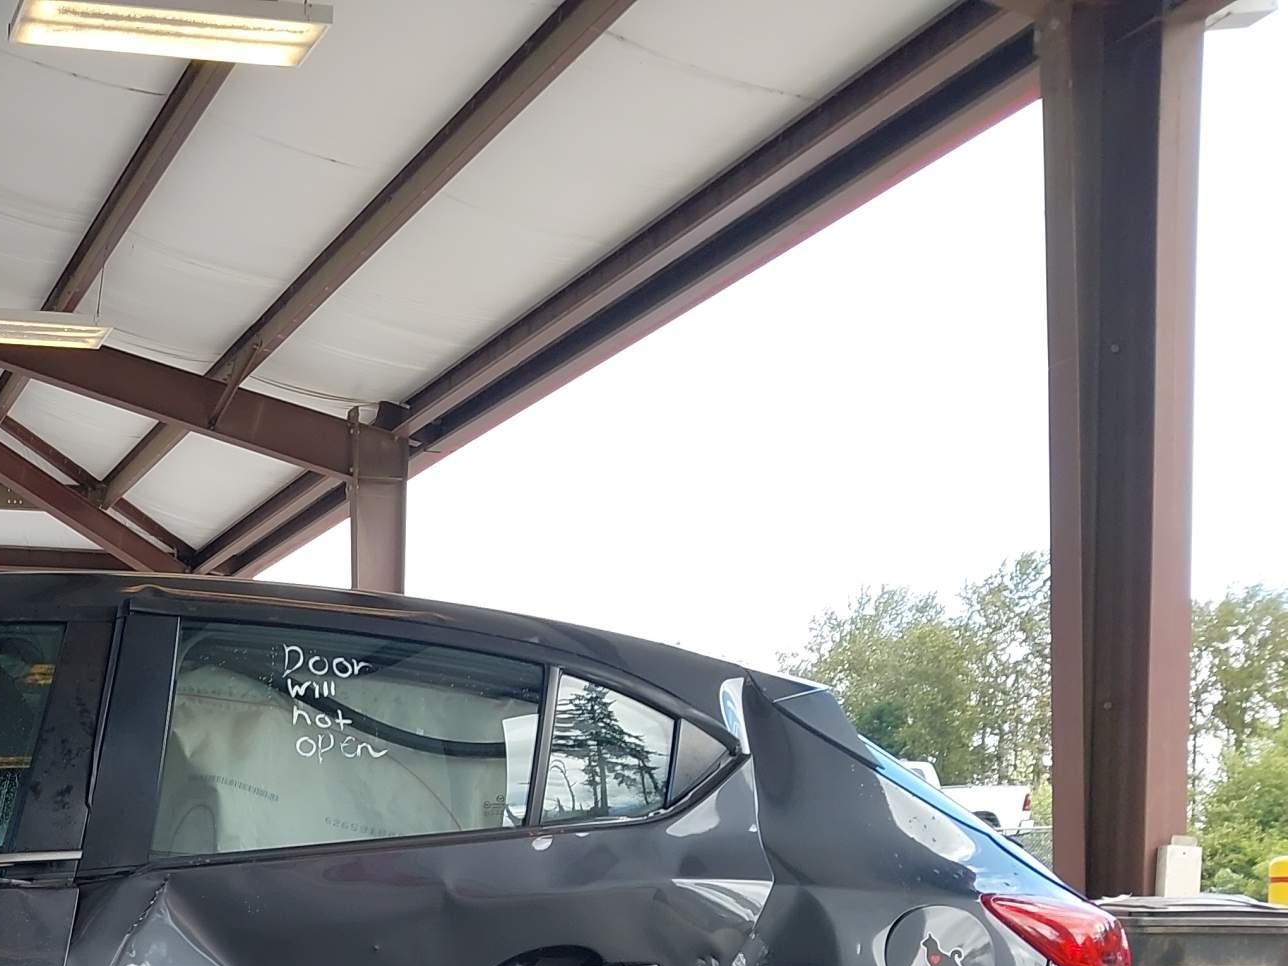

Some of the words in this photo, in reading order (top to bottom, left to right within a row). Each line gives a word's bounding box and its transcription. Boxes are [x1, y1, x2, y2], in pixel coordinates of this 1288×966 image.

[281, 643, 373, 678] Door
[292, 706, 353, 731] not
[295, 730, 389, 763] open
